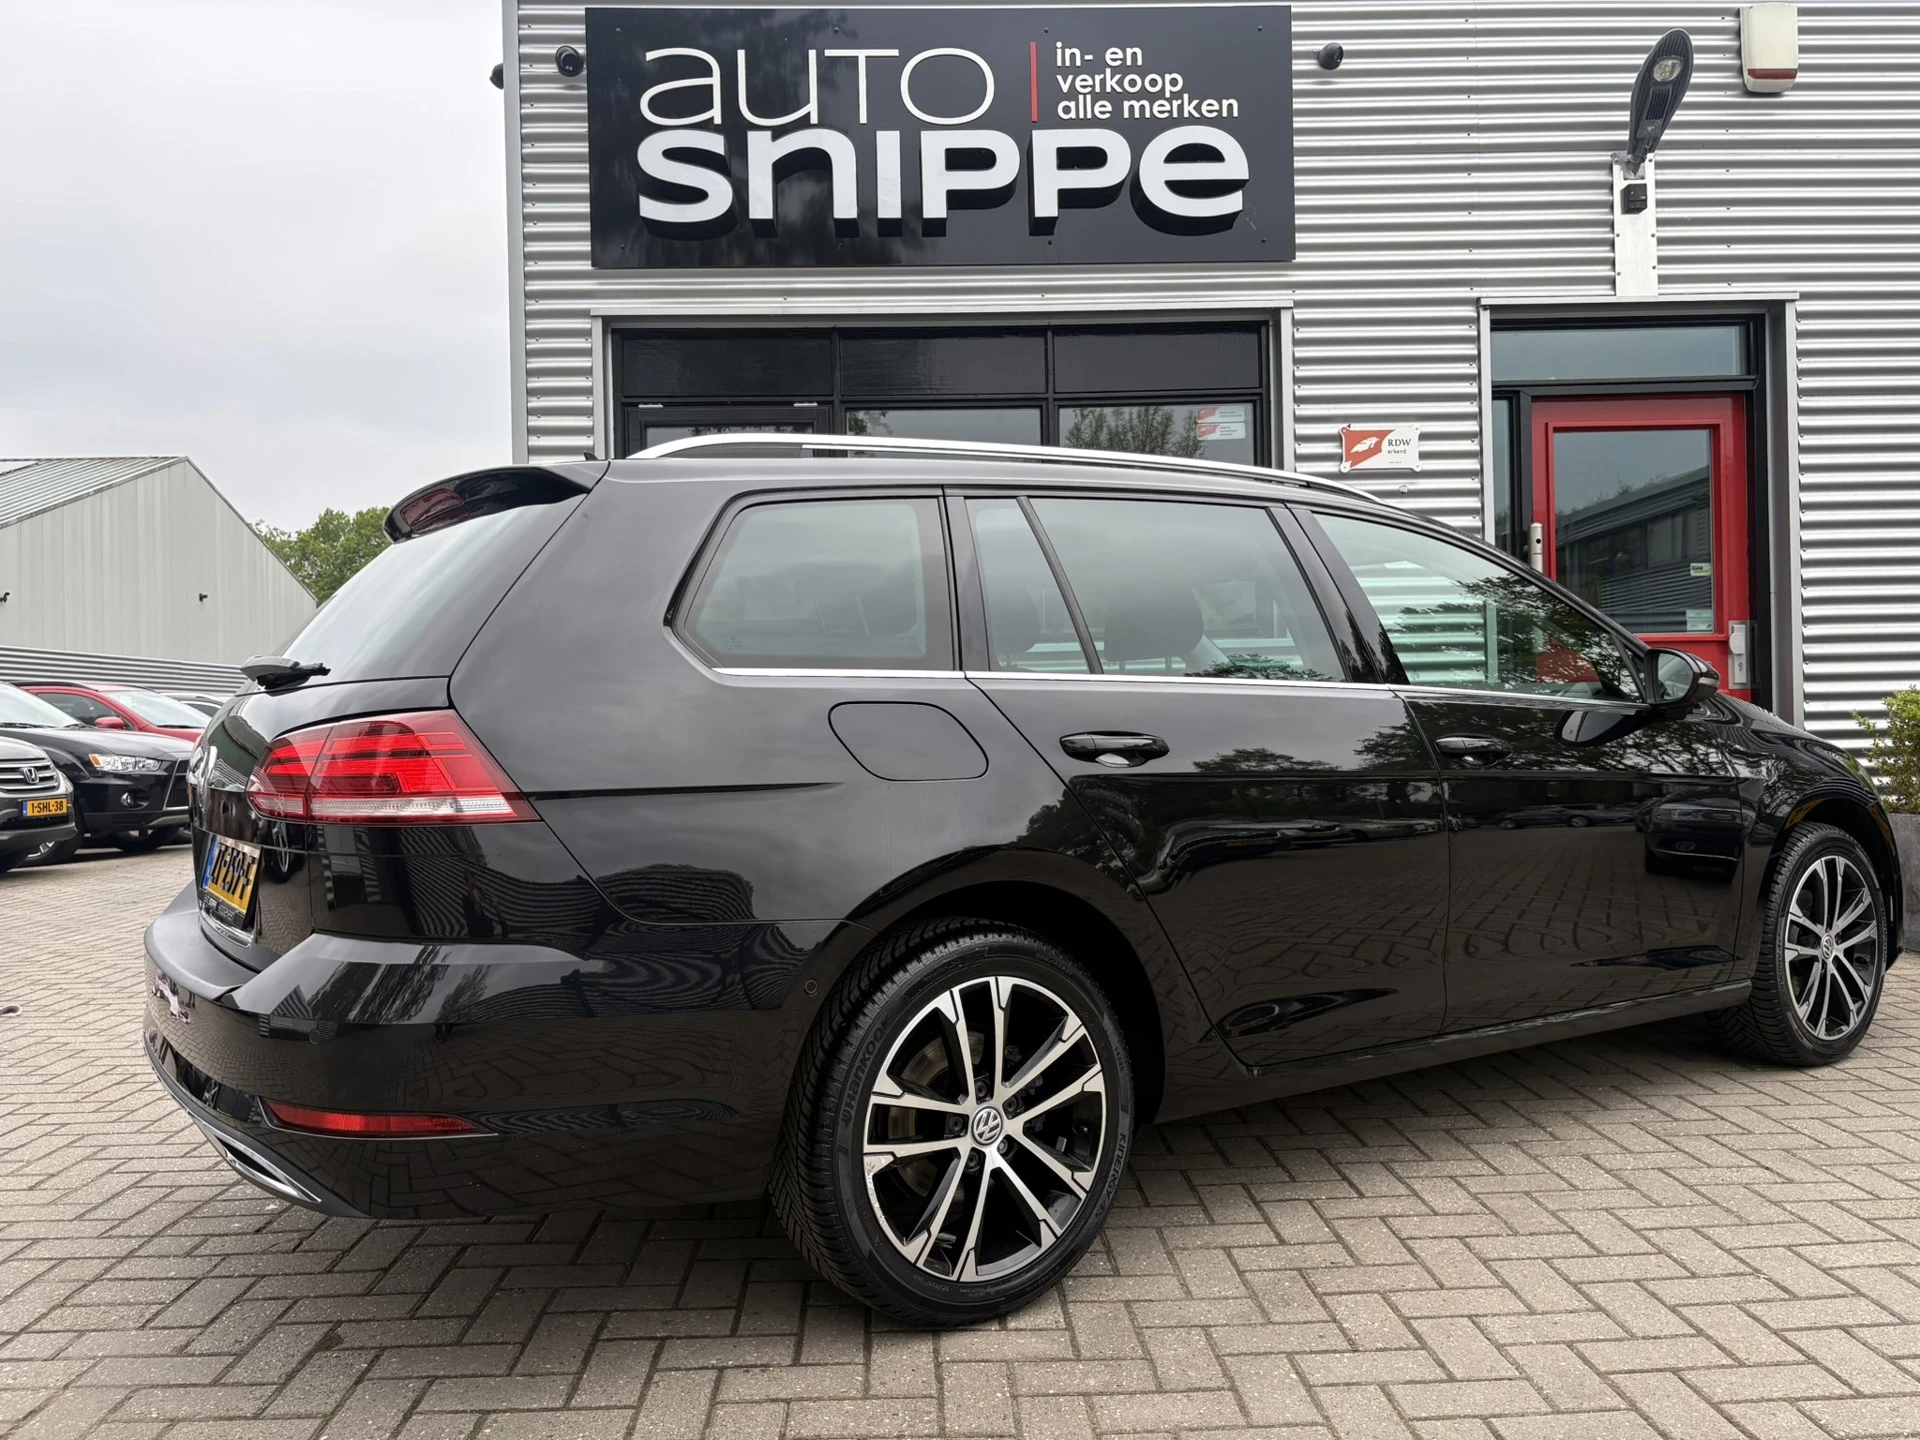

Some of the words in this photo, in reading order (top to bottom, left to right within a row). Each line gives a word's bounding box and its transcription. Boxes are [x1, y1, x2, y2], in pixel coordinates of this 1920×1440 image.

[1055, 41, 1094, 67] in-
[1104, 47, 1143, 67] en
[1055, 67, 1184, 99] verkoop
[1057, 94, 1113, 120] alle
[1123, 93, 1239, 119] merken
[1387, 438, 1412, 447] RDW
[31, 800, 64, 814] 1-SHL-38
